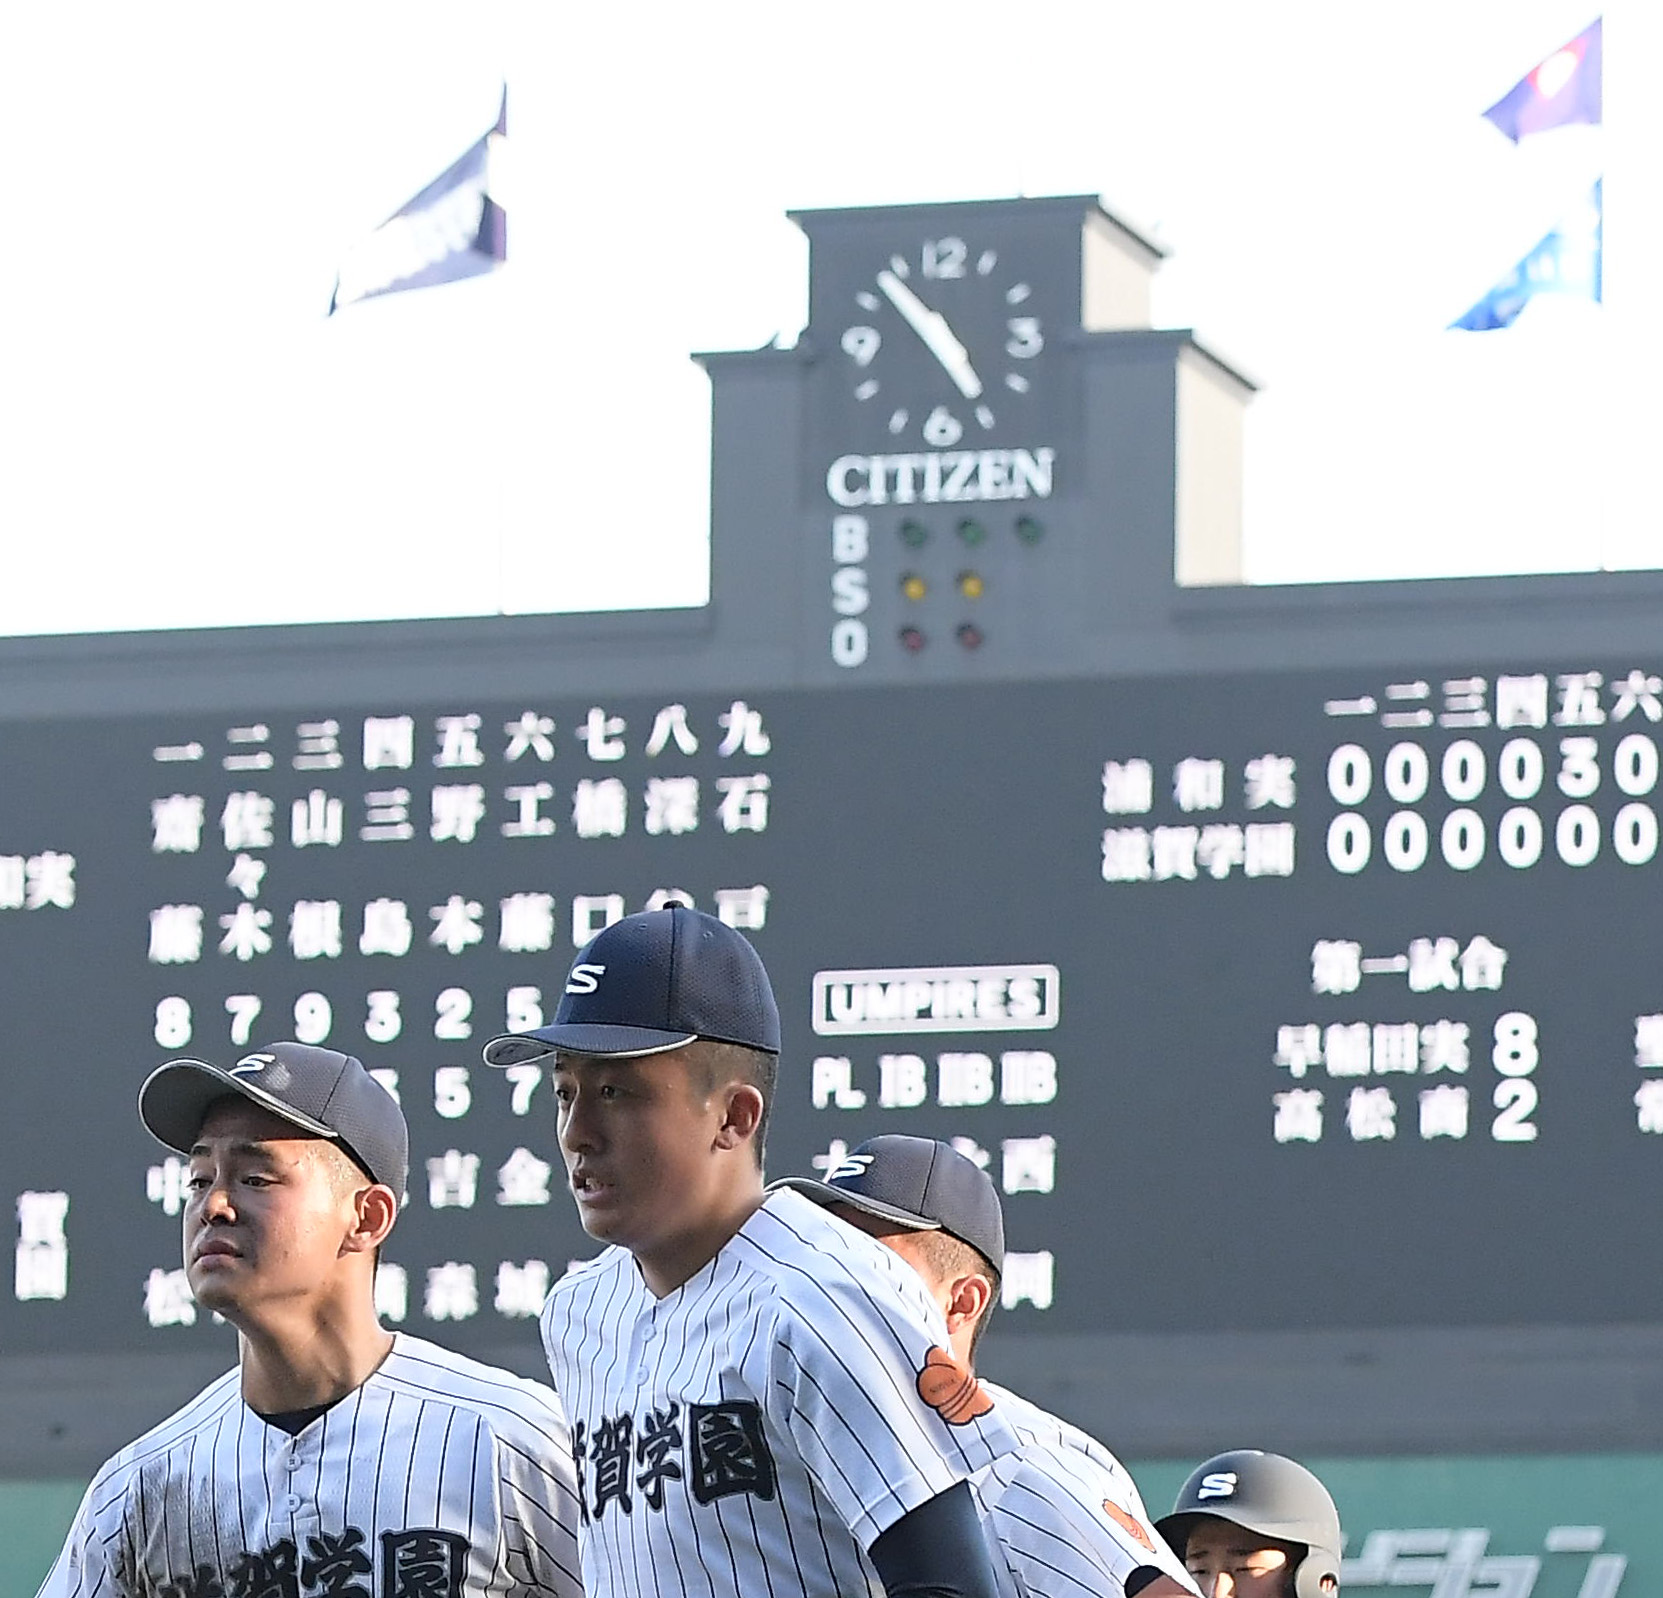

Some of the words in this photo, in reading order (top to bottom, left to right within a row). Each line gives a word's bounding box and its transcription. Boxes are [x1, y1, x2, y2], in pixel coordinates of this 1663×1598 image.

[827, 447, 1054, 506] CITIZEN
[1311, 936, 1507, 994] 第一試合
[830, 980, 1041, 1020] UMPIRES
[1493, 1012, 1538, 1076] 8
[1492, 1079, 1538, 1141] 2
